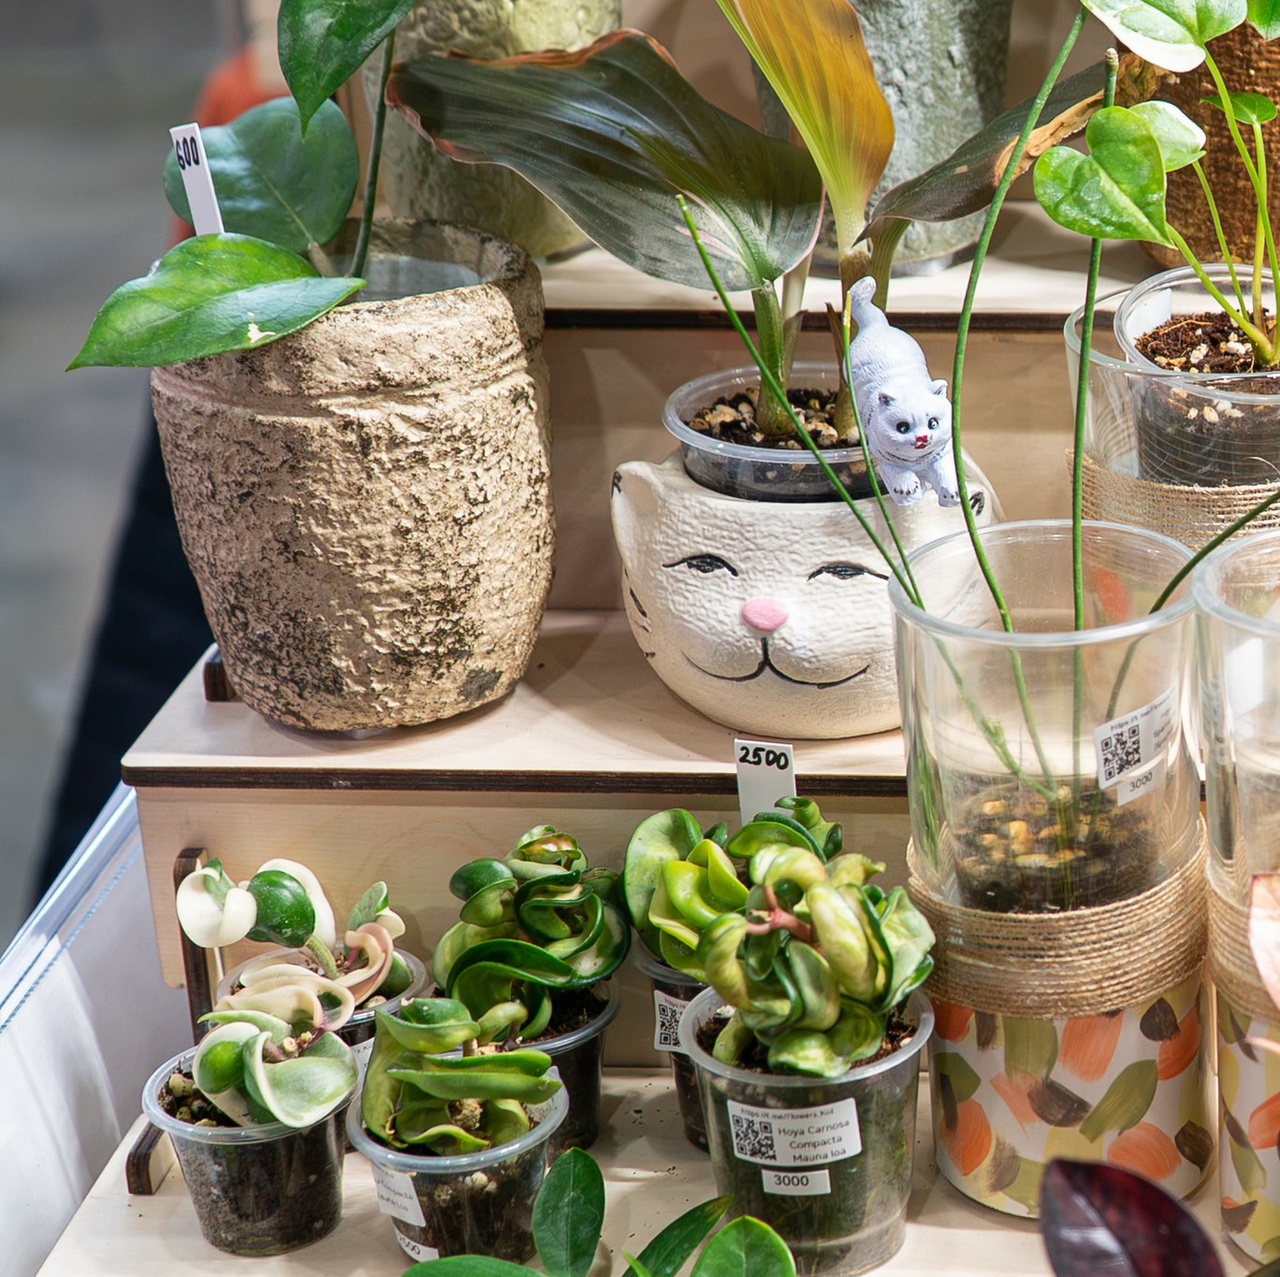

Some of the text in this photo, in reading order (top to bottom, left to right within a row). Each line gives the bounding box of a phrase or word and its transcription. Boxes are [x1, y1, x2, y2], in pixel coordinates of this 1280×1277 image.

[176, 135, 200, 171] 600
[738, 745, 790, 771] 2500
[1128, 770, 1153, 793] 3000
[778, 1118, 851, 1139] Hoya Carnosa
[788, 1135, 843, 1150] Compacta
[792, 1152, 829, 1164] Mauna
[773, 1173, 810, 1188] 3000
